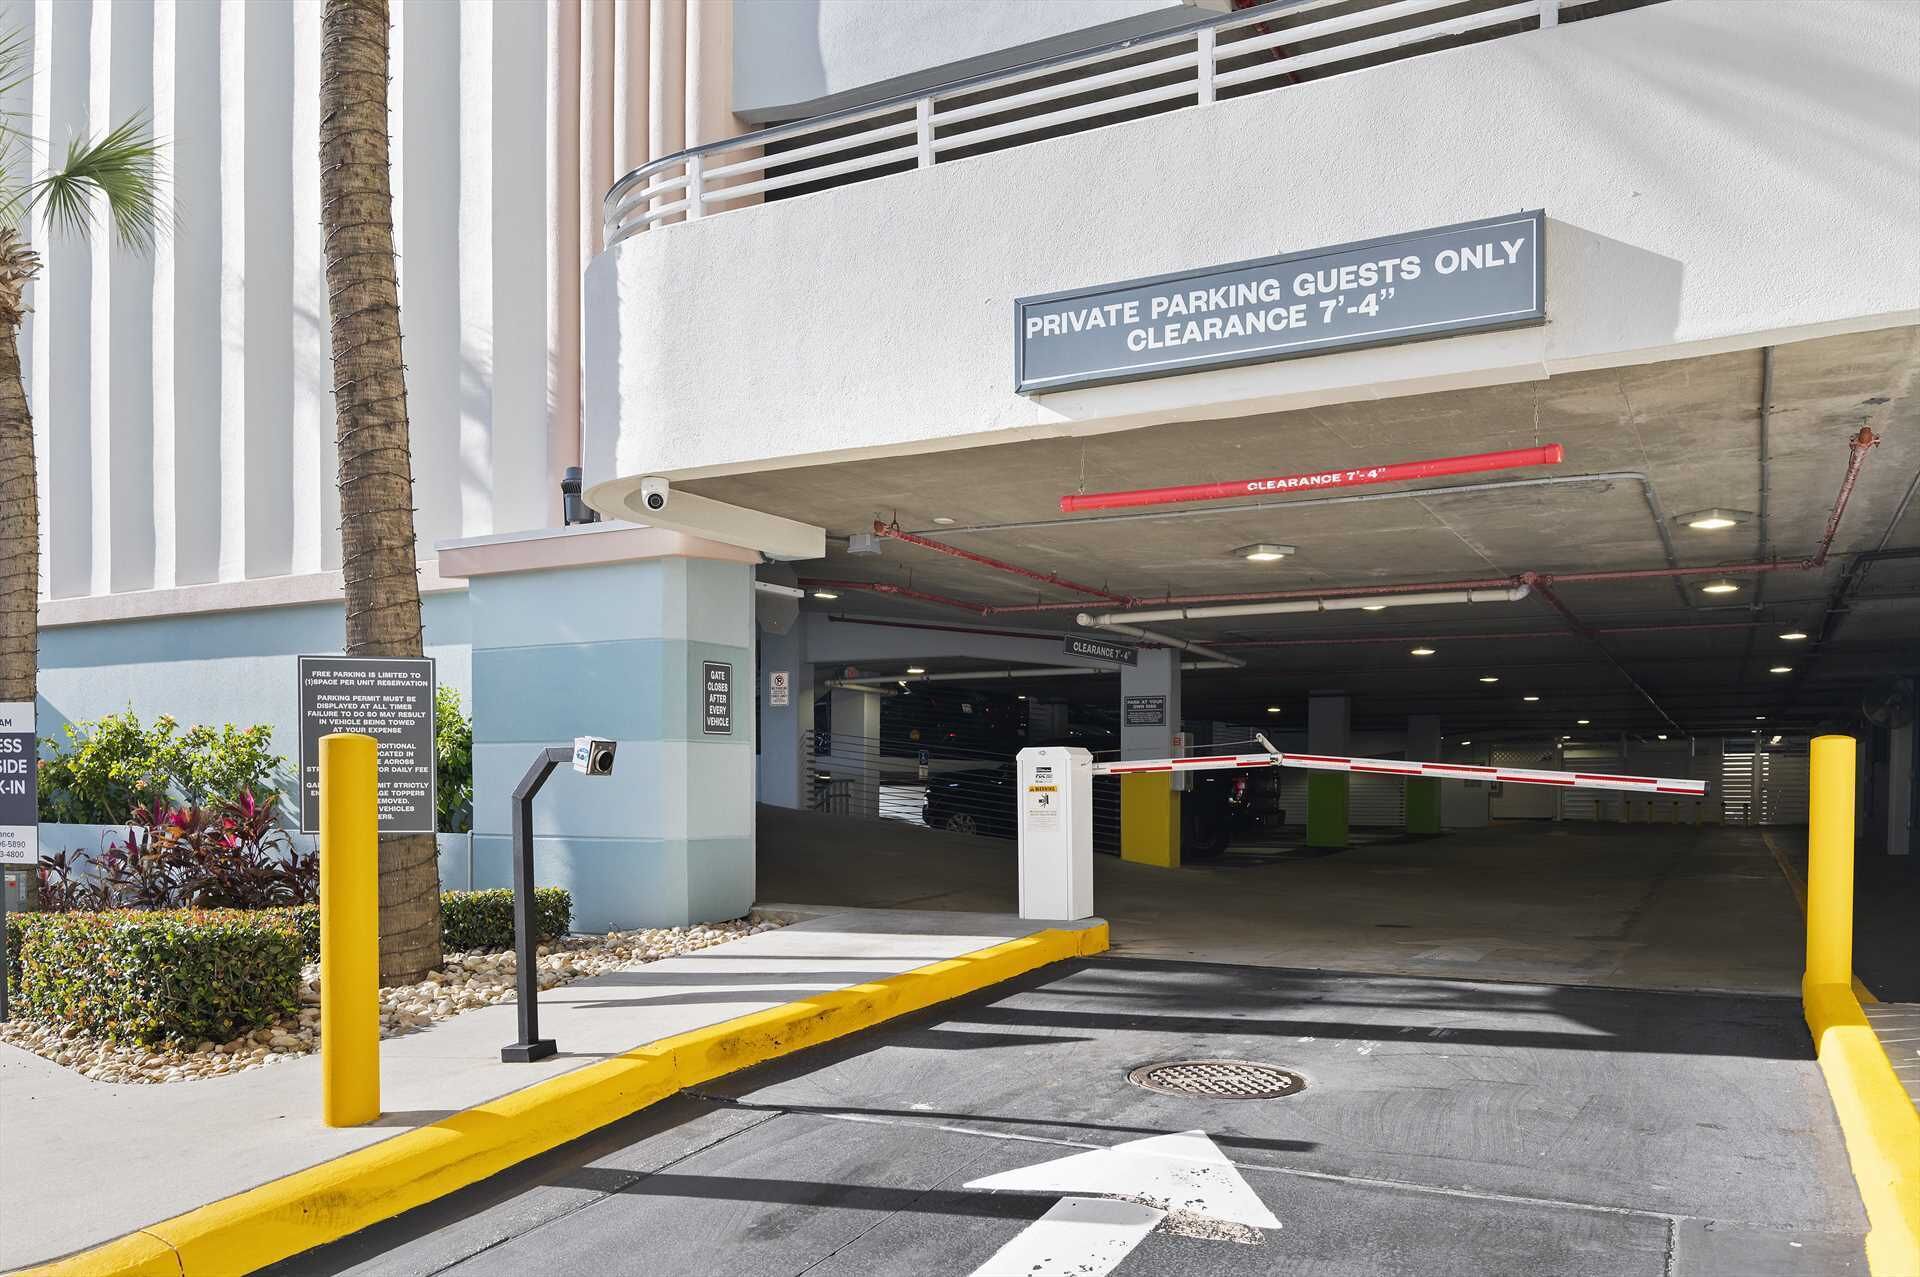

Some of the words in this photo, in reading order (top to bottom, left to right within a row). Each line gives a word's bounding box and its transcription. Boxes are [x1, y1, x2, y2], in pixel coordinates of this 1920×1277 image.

[1026, 300, 1140, 339] PRIVATE
[1152, 278, 1280, 320] PARKING
[1293, 255, 1421, 297] GUESTS
[1434, 238, 1525, 275] ONLY
[1127, 304, 1306, 352] CLEARANCE
[1247, 473, 1342, 491] CLEARANCE
[1073, 642, 1114, 658] CLEARANCE
[711, 670, 725, 680] GATE
[707, 682, 728, 692] CLOSES
[709, 694, 727, 703] AFTER
[709, 706, 726, 715] EVERY
[707, 717, 729, 727] VEHICLE
[0, 759, 27, 774] IDE
